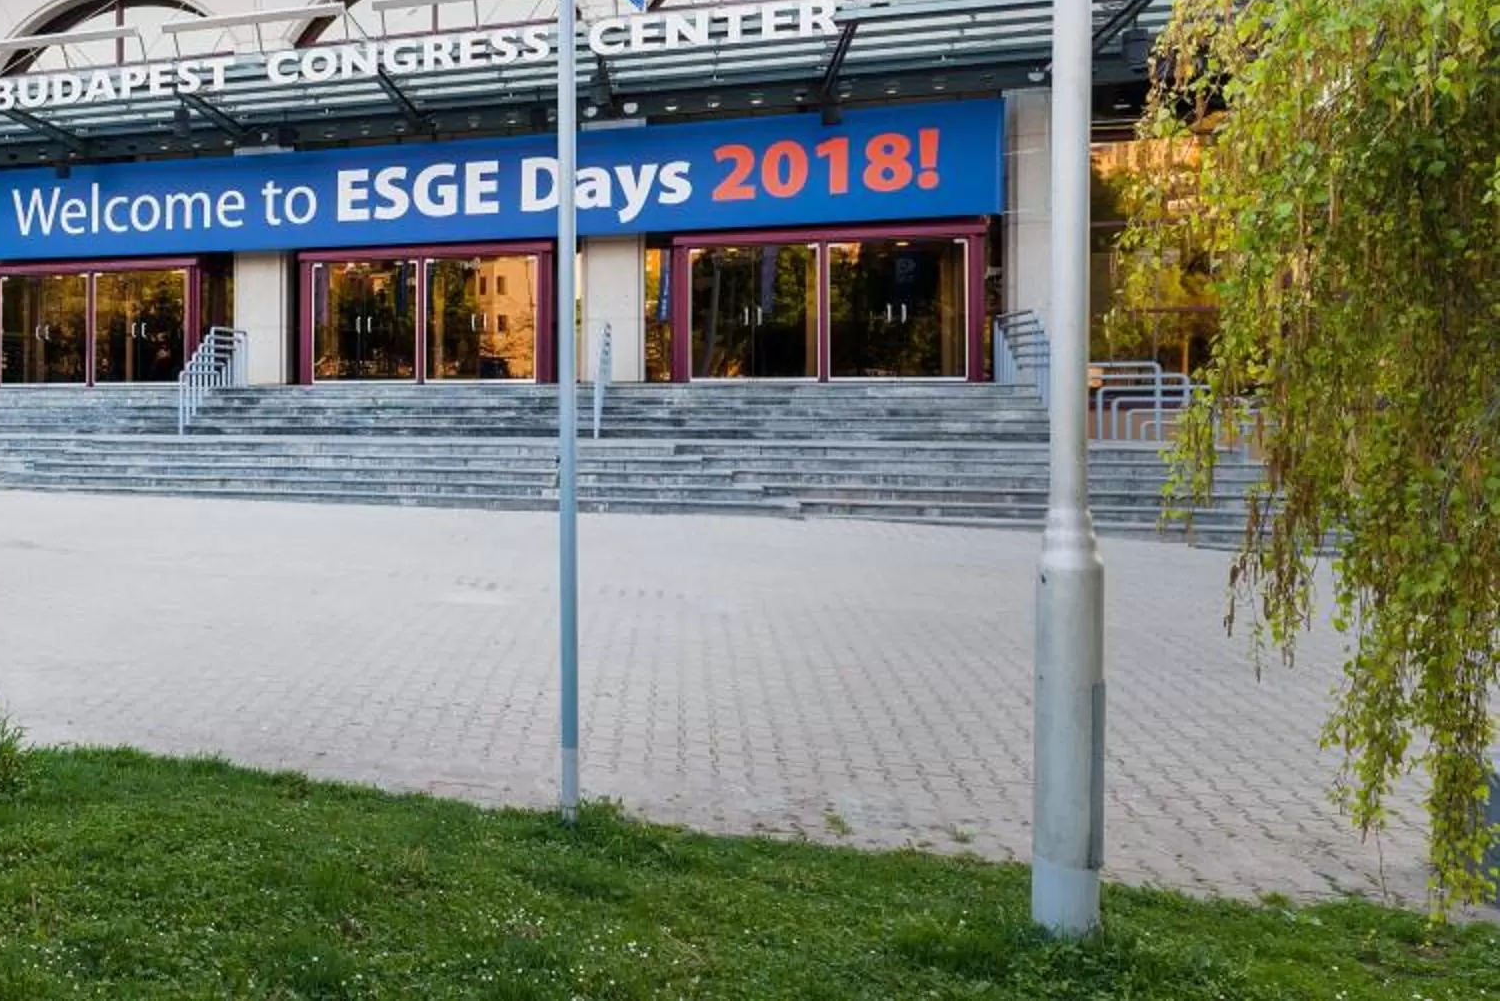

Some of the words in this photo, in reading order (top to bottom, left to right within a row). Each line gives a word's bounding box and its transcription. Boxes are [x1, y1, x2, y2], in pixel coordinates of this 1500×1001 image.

[267, 24, 550, 82] CONGRESS
[12, 182, 246, 235] Welcome
[262, 179, 318, 226] to
[337, 159, 499, 222] ESGE
[519, 155, 692, 223] Days
[711, 127, 941, 201] 2018!
